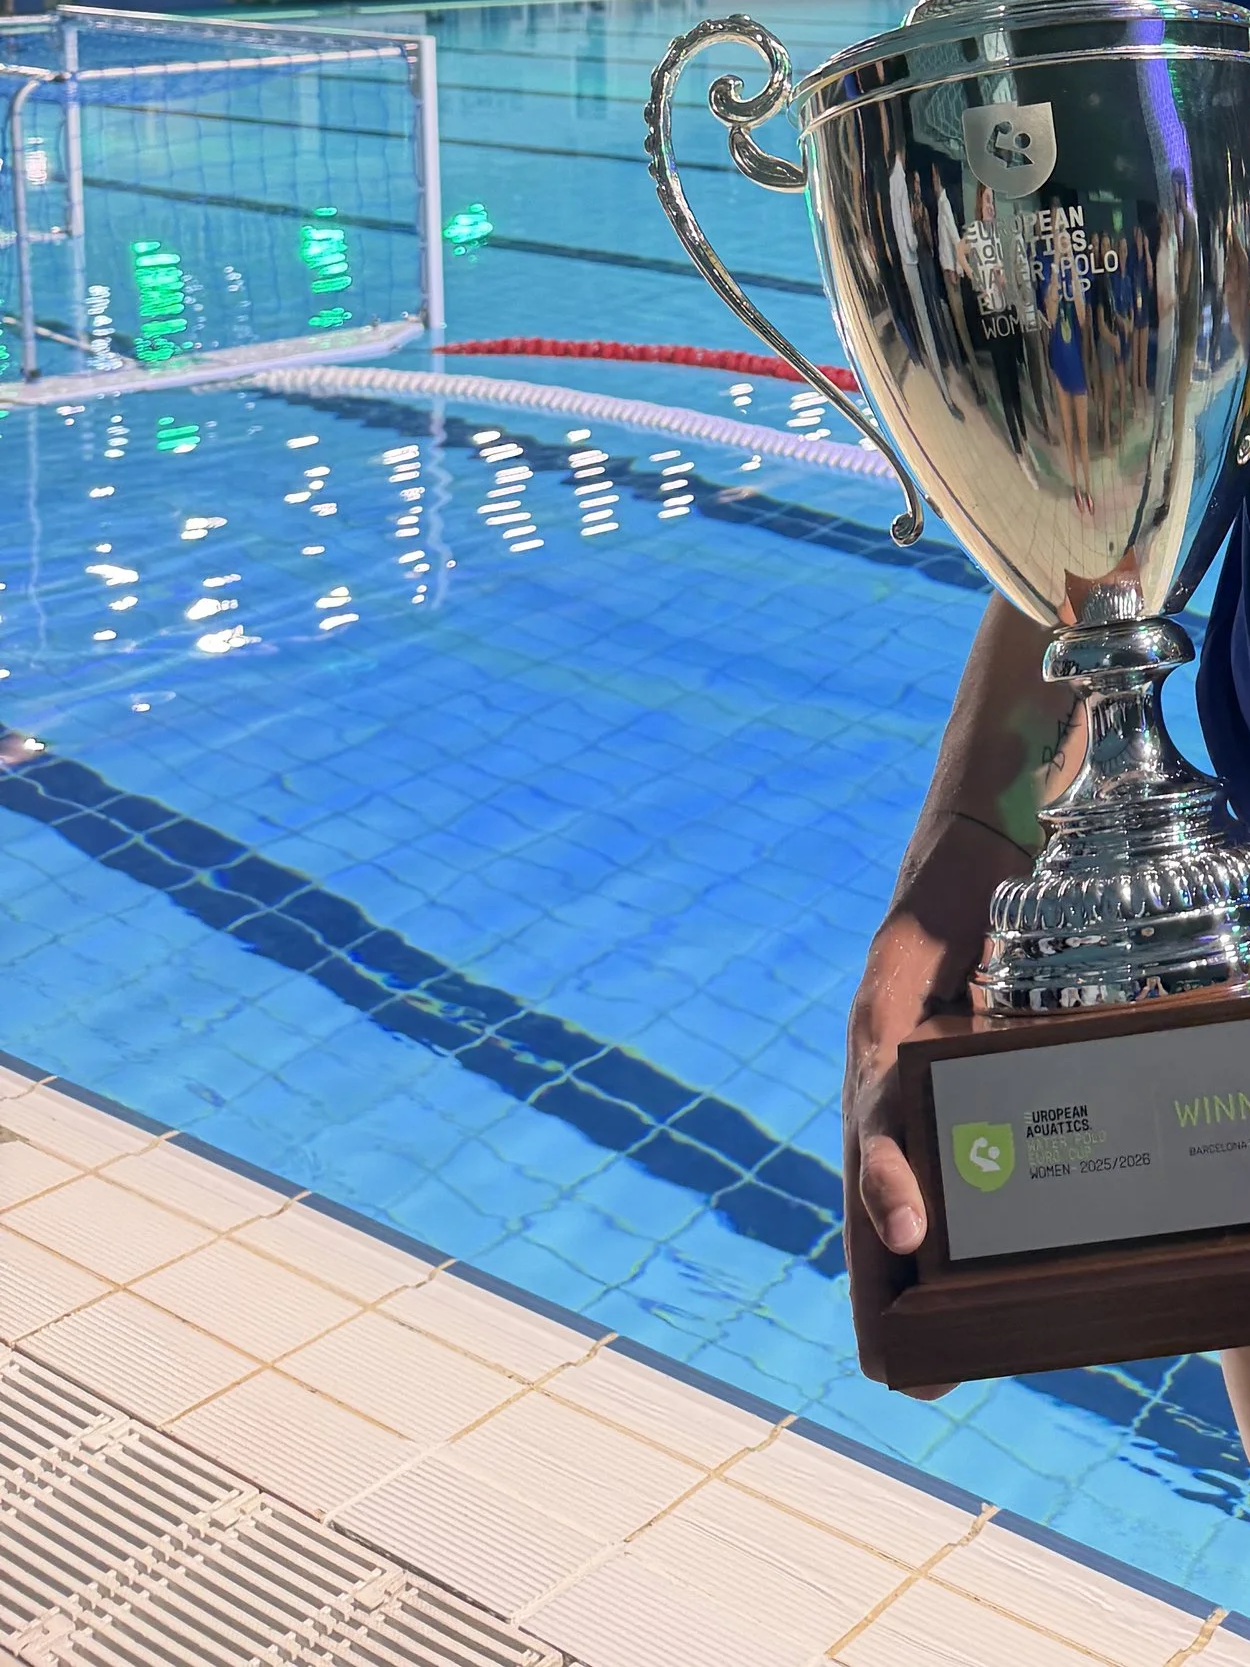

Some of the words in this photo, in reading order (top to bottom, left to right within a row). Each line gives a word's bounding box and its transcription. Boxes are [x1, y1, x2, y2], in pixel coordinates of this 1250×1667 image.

[963, 206, 1084, 243] EUROPEAN
[1060, 250, 1118, 278] POLO
[981, 309, 1052, 341] WOMEN
[1189, 1142, 1248, 1157] BARCELONA
[1030, 1163, 1070, 1179] WOMEN
[1080, 1153, 1151, 1173] 2025/2026
